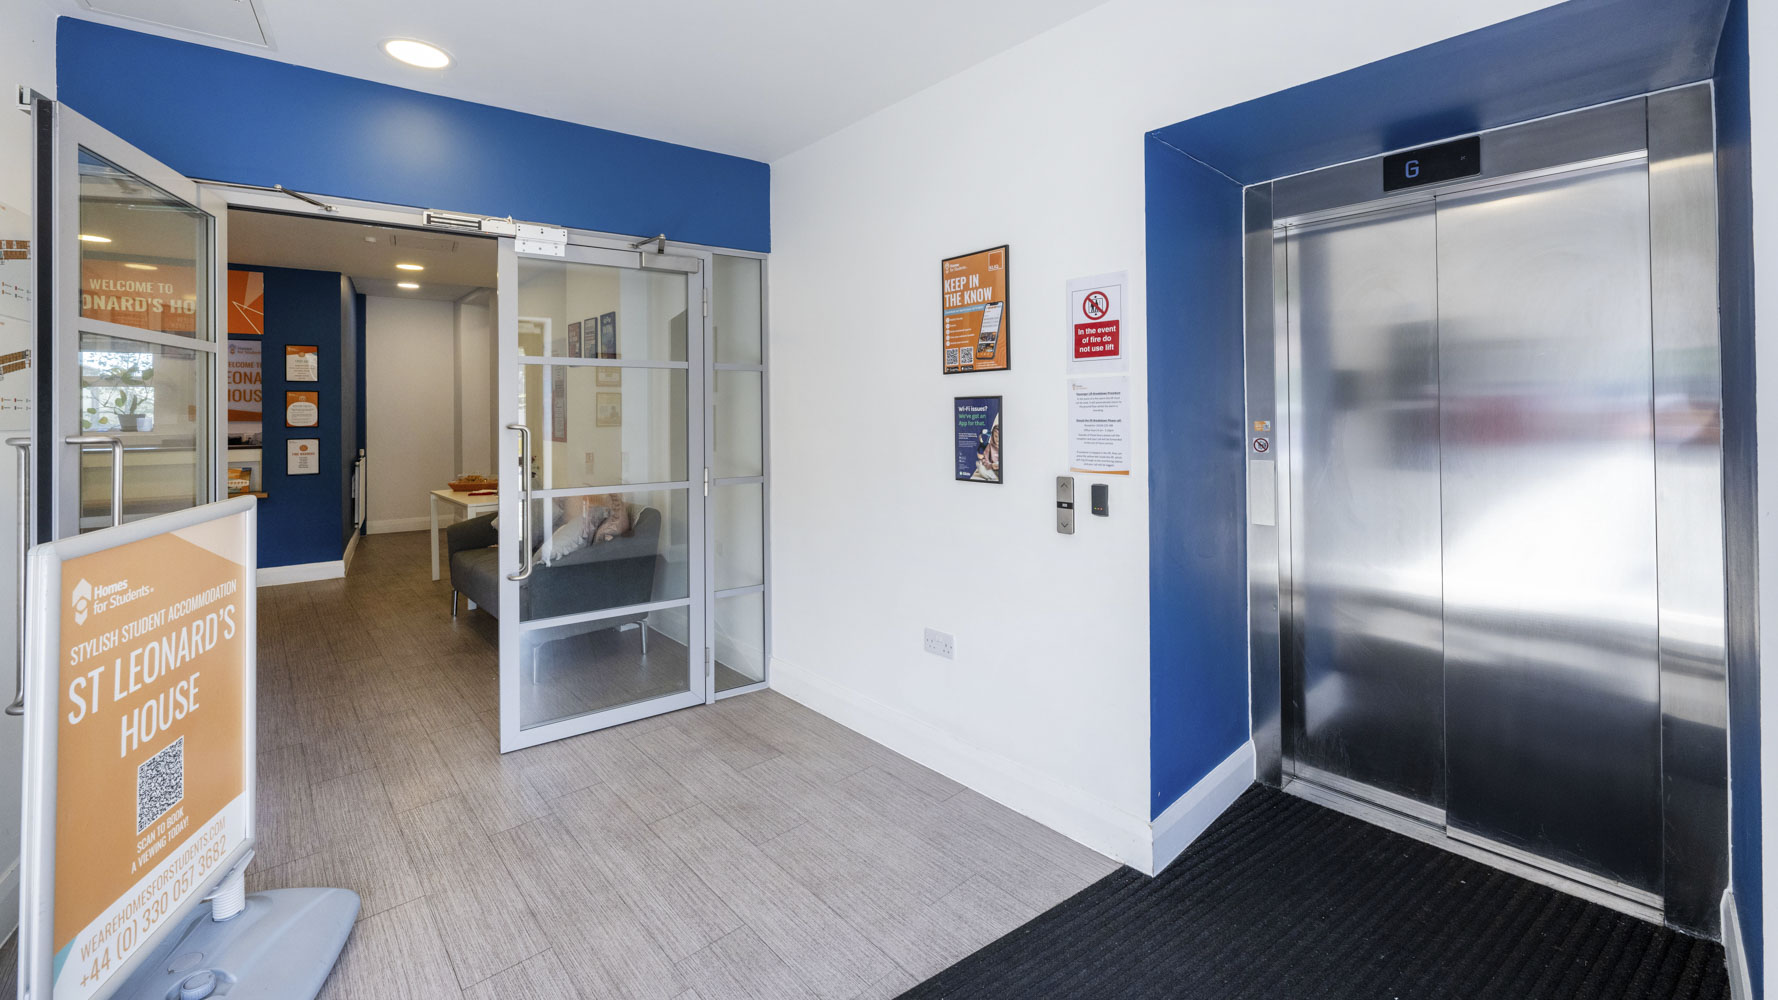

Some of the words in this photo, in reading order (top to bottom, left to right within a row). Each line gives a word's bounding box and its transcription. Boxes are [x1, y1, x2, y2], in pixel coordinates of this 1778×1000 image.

[1405, 160, 1420, 179] G
[90, 279, 153, 293] WELCOME
[158, 283, 173, 294] TO
[945, 276, 966, 292] KEEP
[969, 273, 979, 288] IN
[945, 292, 961, 307] THE
[964, 286, 992, 304] KNOW
[1097, 325, 1116, 333] event
[94, 578, 128, 599] Homes
[70, 628, 119, 666] STYLISH
[121, 609, 166, 643] STUDENT
[168, 579, 237, 622] ACCOMMODATION
[93, 600, 107, 615] for
[68, 665, 105, 725] ST
[121, 671, 200, 758] HOUSE
[131, 861, 137, 875] A
[138, 835, 167, 867] VIEWING
[168, 815, 189, 842] TODAY!
[137, 829, 156, 854] SCAN
[157, 821, 166, 837] TO
[166, 805, 184, 829] BOOK
[80, 816, 226, 962] WEAREHOMESFORSTUDENTS.COM
[80, 947, 111, 987] +44
[116, 918, 138, 960] (0)
[142, 891, 169, 934] 330
[173, 865, 195, 902] 057
[198, 834, 226, 877] 3682
